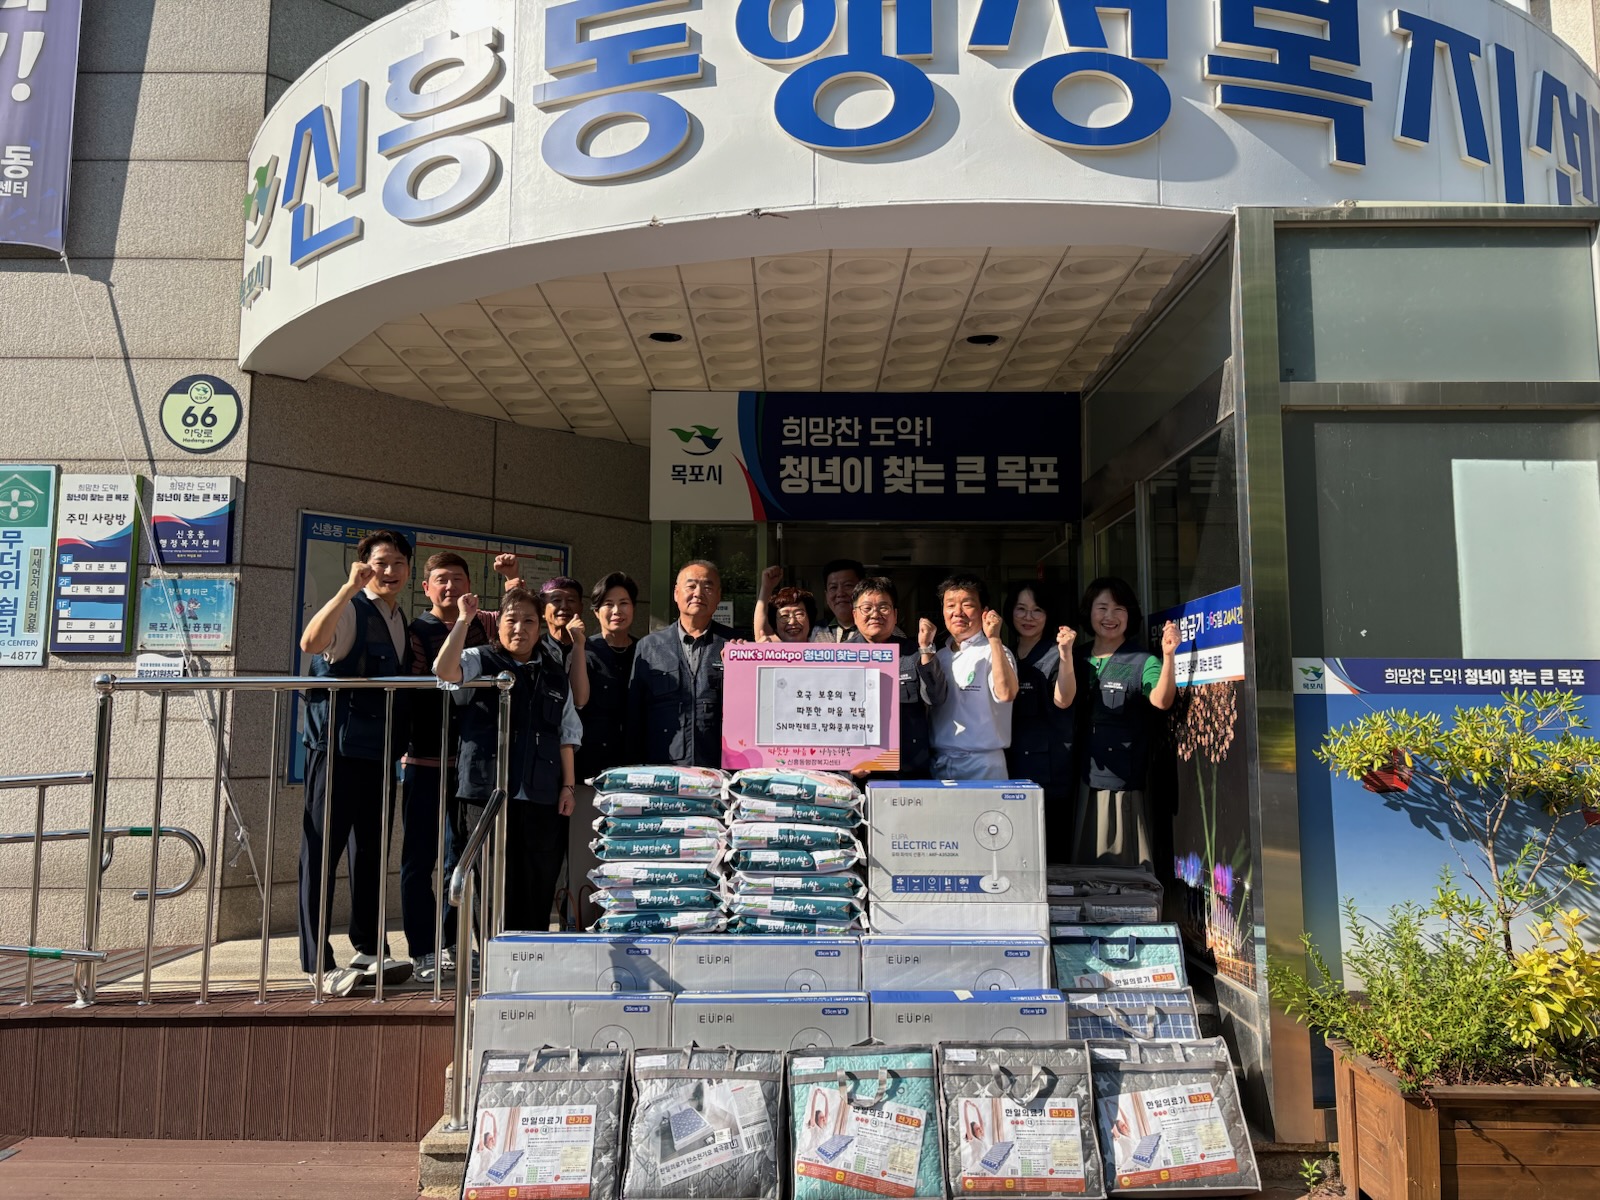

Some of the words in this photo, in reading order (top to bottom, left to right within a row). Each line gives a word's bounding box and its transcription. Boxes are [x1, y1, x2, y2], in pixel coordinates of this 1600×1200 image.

[182, 406, 218, 428] 66
[780, 416, 862, 447] 희망찬
[869, 416, 932, 447] 도약!
[670, 464, 723, 485] 목포시
[780, 456, 873, 494] 청년이
[882, 456, 945, 494] 찾는
[955, 456, 986, 494] 큰
[996, 456, 1060, 494] 목포
[66, 513, 88, 526] 주민
[92, 513, 127, 526] 사랑방
[310, 522, 343, 538] 신흥동
[30, 548, 42, 588] 미세먼지
[28, 590, 39, 610] 쉼터
[729, 650, 763, 662] PINK's
[765, 650, 802, 662] Mokpo
[804, 650, 834, 662] 청년이
[836, 650, 857, 661] 찾는
[859, 650, 870, 661] 큰
[872, 650, 893, 662] 목포
[1384, 668, 1426, 685] 희망찬
[1430, 669, 1462, 685] 도약!
[1464, 669, 1506, 685] 청년이
[1509, 669, 1536, 685] 찾는
[1540, 669, 1554, 685] 큰
[1557, 669, 1585, 685] 목포
[796, 690, 812, 700] 호국
[818, 690, 843, 700] 보훈의
[849, 690, 857, 701] 달
[796, 706, 822, 717] 따뜻한
[827, 707, 843, 717] 마음
[892, 798, 922, 806] EUPA
[892, 841, 937, 850] ELECTRIC
[940, 841, 959, 850] FAN
[512, 952, 543, 961] EUPA
[699, 955, 730, 964] EUPA
[888, 955, 920, 964] EUPA
[501, 1011, 535, 1020] EUPA
[700, 1014, 732, 1023] EUPA
[897, 1014, 932, 1023] EUPA
[1146, 1096, 1186, 1109] 한일의료기
[1191, 1094, 1212, 1103] 전기요
[1005, 1108, 1046, 1117] 한일의료기
[568, 1116, 590, 1124] 전기요
[897, 1116, 920, 1127] 전기요
